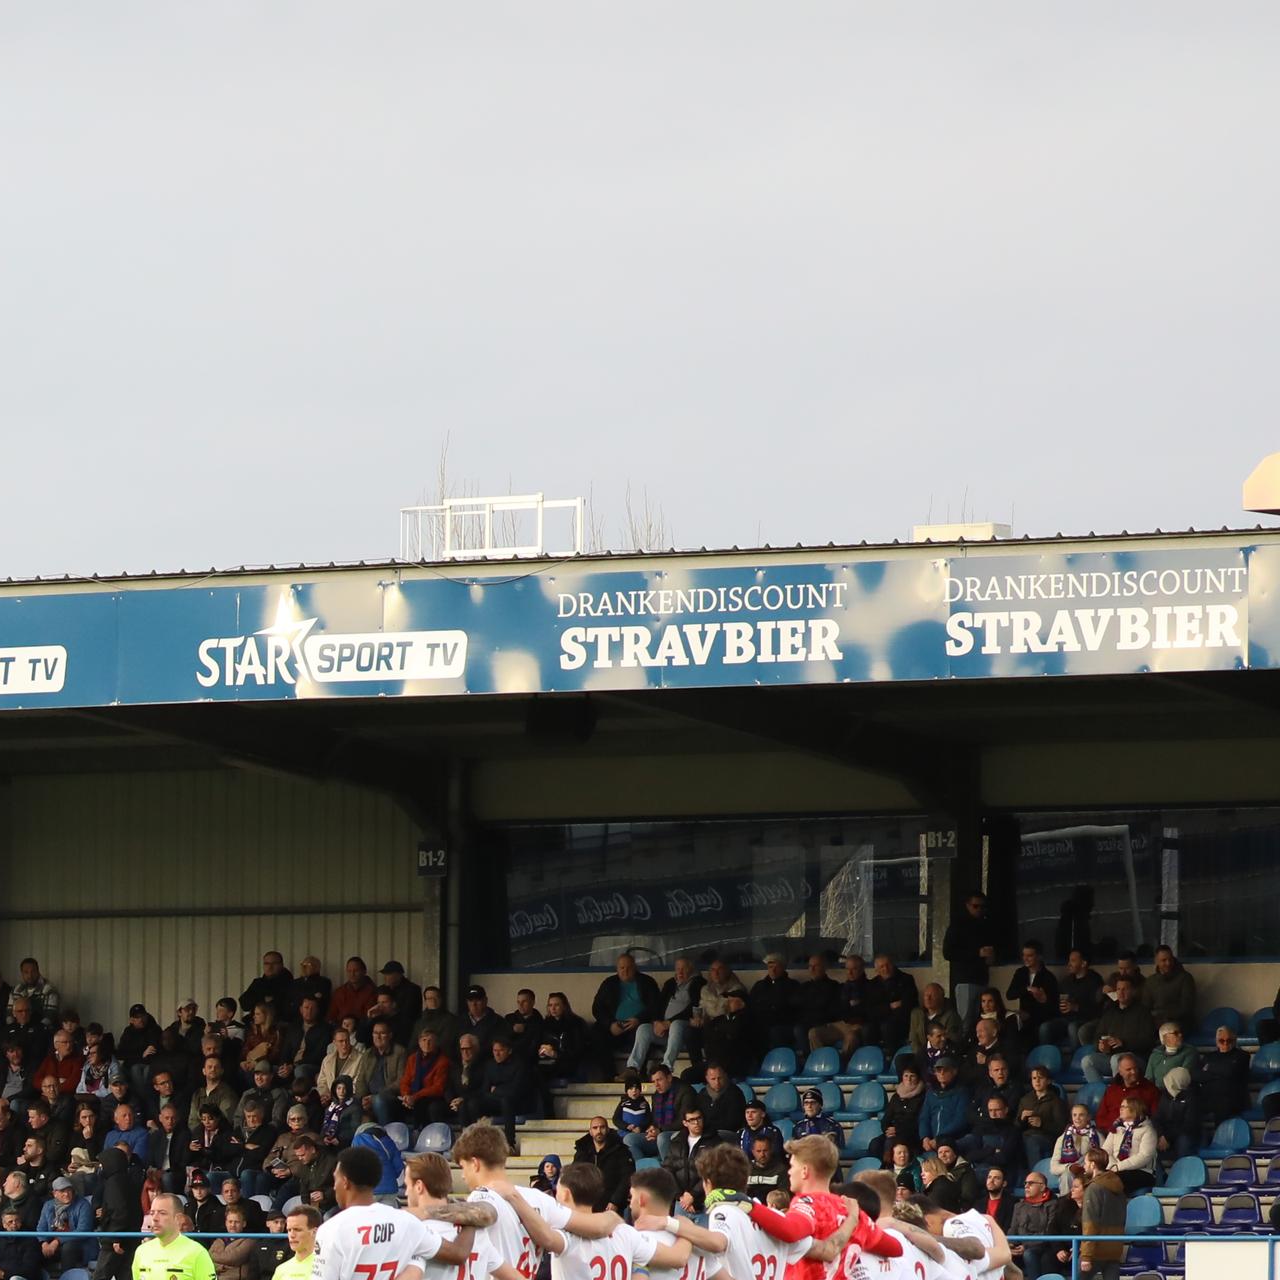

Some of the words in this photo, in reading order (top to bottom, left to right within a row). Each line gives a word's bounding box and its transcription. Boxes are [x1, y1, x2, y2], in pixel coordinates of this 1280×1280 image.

[557, 583, 847, 617] DRANKENDISCOUNT
[943, 567, 1247, 602] DRANKENDISCOUNT
[559, 619, 843, 670] STRAVBIER
[945, 604, 1241, 656] STRAVBIER
[28, 657, 58, 681] TV
[196, 635, 297, 687] STAR
[317, 641, 413, 673] SPORT
[426, 642, 458, 667] TV
[928, 830, 956, 848] B1-2
[418, 850, 445, 867] B1-2
[357, 1226, 372, 1245] 7
[373, 1223, 395, 1244] CUP
